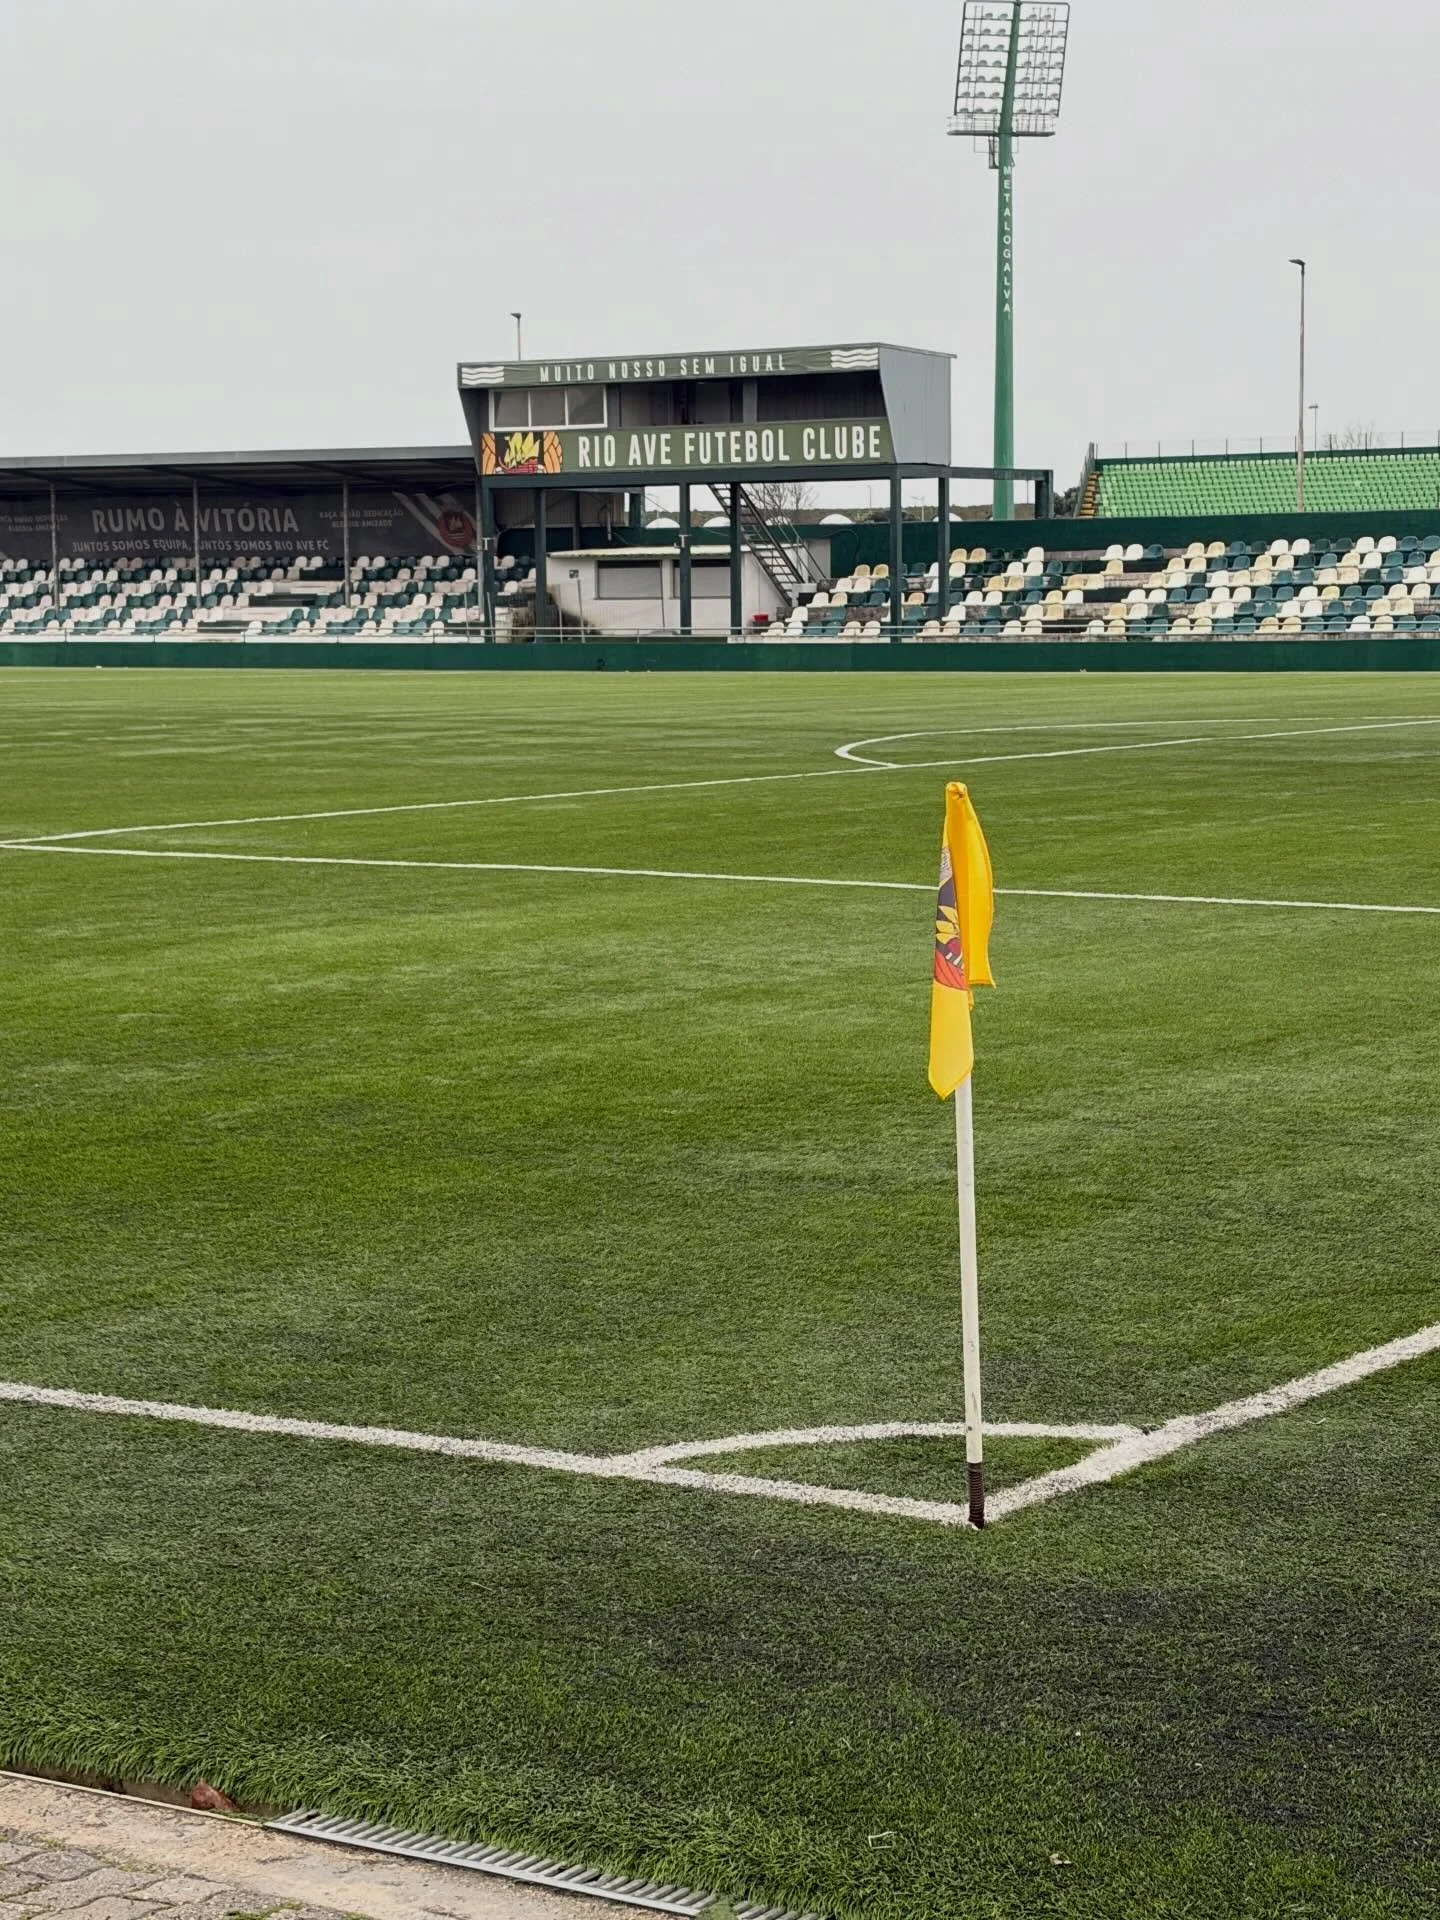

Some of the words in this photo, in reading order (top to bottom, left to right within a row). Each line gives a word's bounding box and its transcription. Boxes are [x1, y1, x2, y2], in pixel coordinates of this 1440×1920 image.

[1003, 166, 1011, 313] METALOGALVA
[540, 364, 595, 382] MUITO
[609, 361, 665, 380] NOSSO
[680, 358, 715, 376] SEM
[730, 354, 786, 374] IGUAL
[578, 434, 616, 467] RIO
[629, 432, 672, 466] AVE
[684, 428, 790, 465] FUTEBOL
[803, 425, 881, 461] CLUBE
[92, 508, 165, 533] RUMO
[174, 502, 190, 532] À
[197, 502, 300, 533] VITÓRIA
[72, 541, 109, 553] JUNTOS
[111, 540, 150, 552] SOMOS
[234, 540, 272, 551] SOMOS
[275, 540, 293, 551] RIO
[296, 540, 315, 551] AVE
[316, 540, 329, 551] FC
